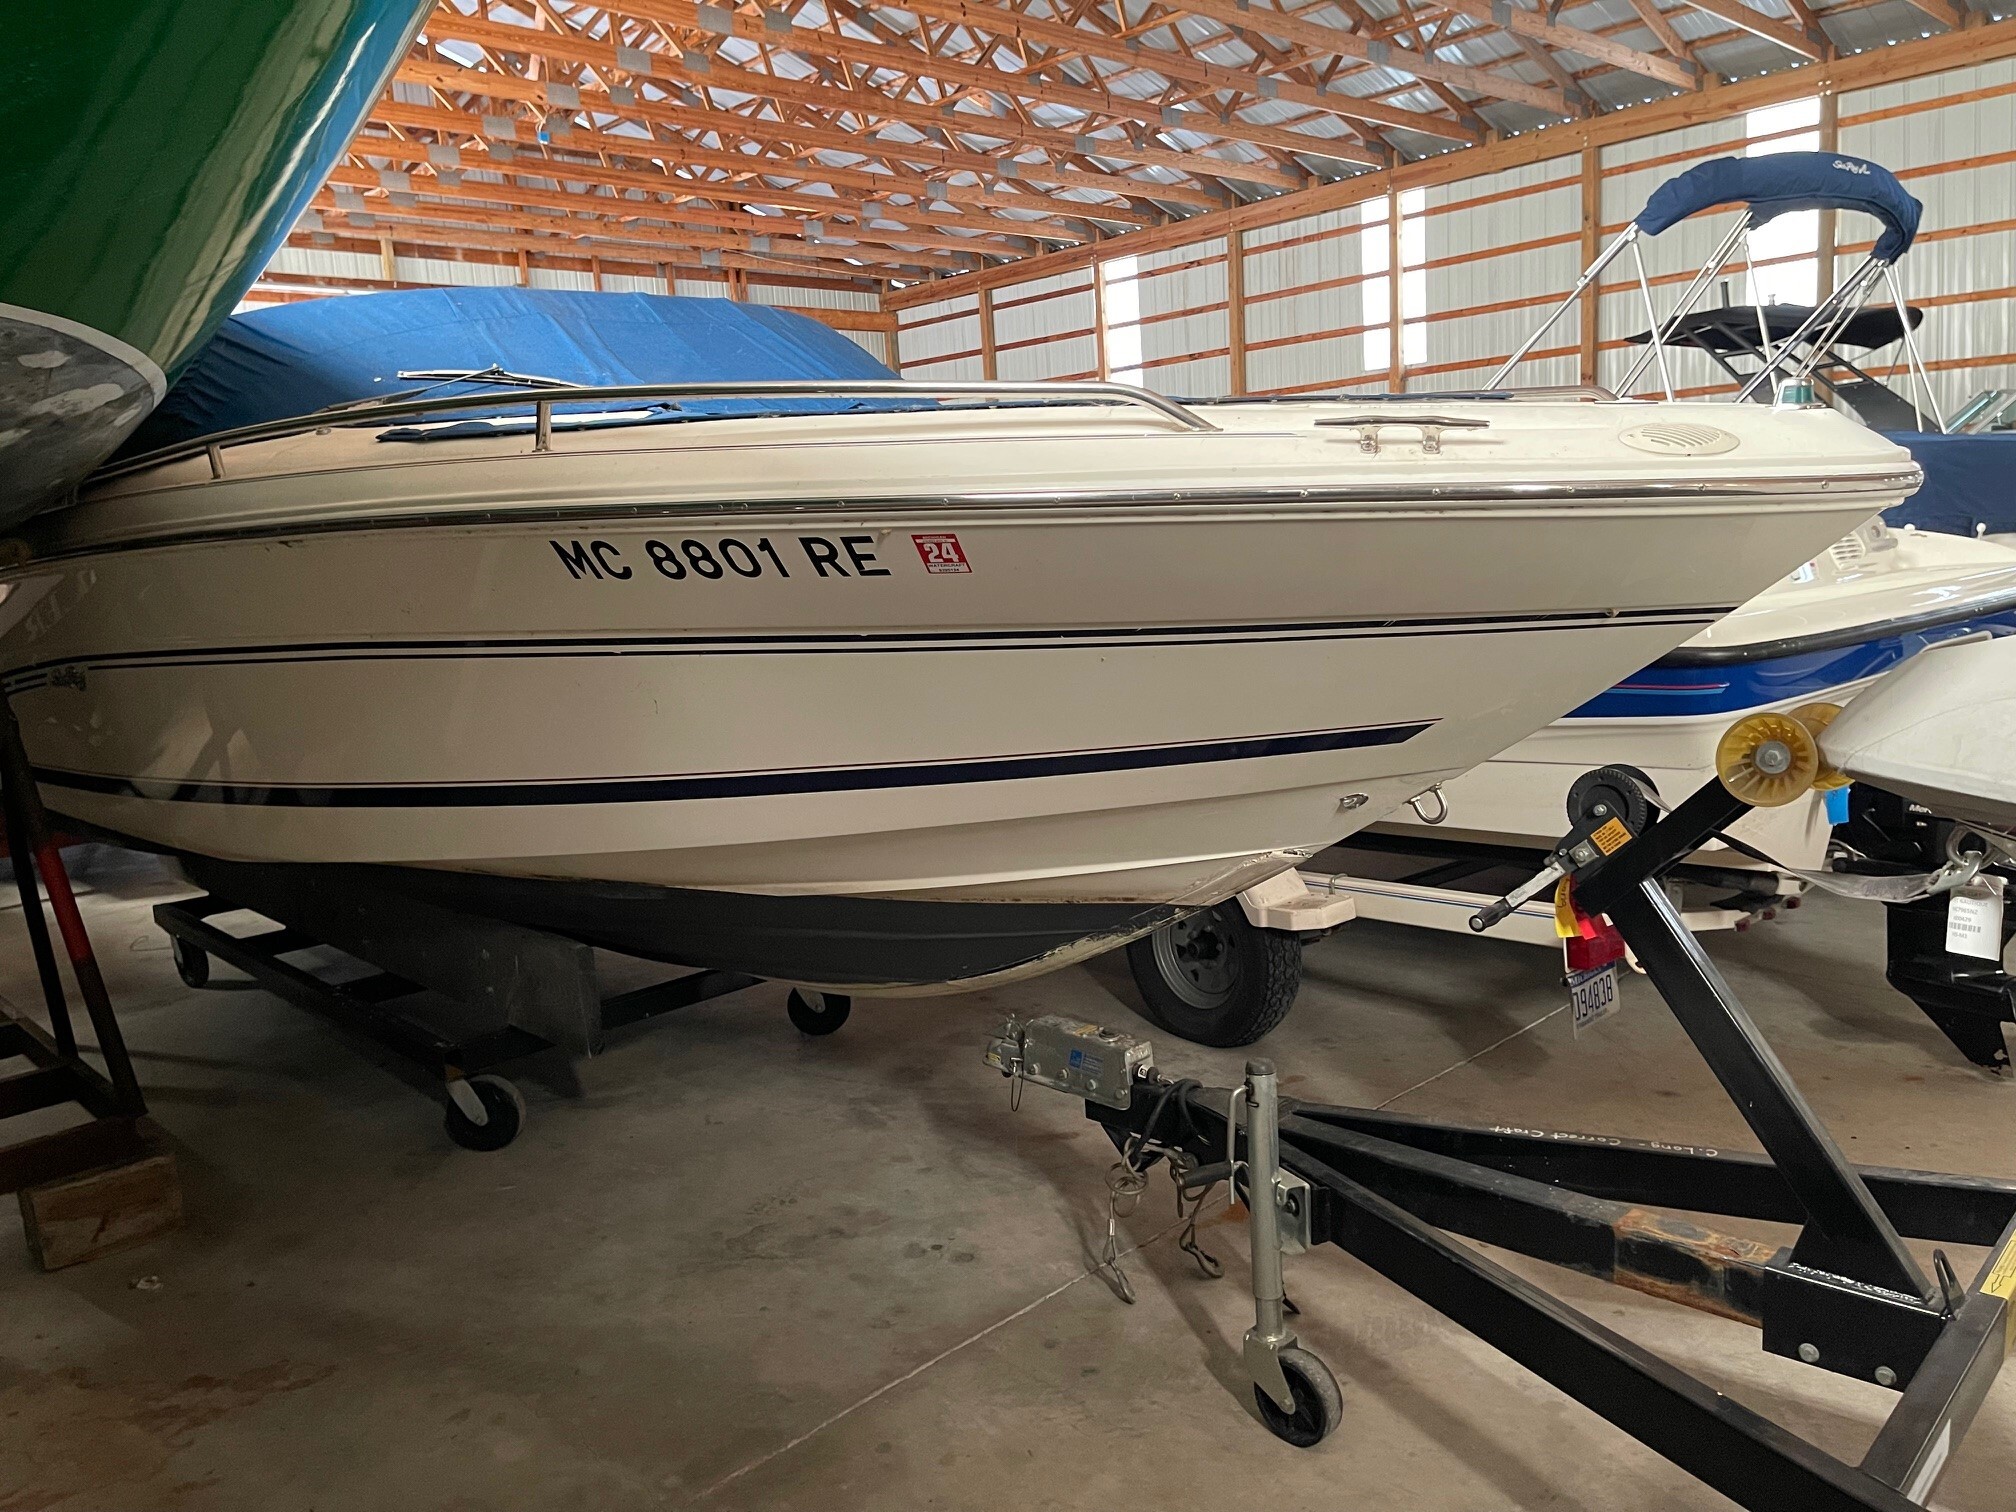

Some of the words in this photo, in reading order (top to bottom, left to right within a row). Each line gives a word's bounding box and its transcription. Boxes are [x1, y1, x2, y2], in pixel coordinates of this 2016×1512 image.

[549, 540, 633, 579] MC
[645, 537, 791, 580] 8801
[798, 535, 892, 577] RE
[923, 543, 960, 563] 24
